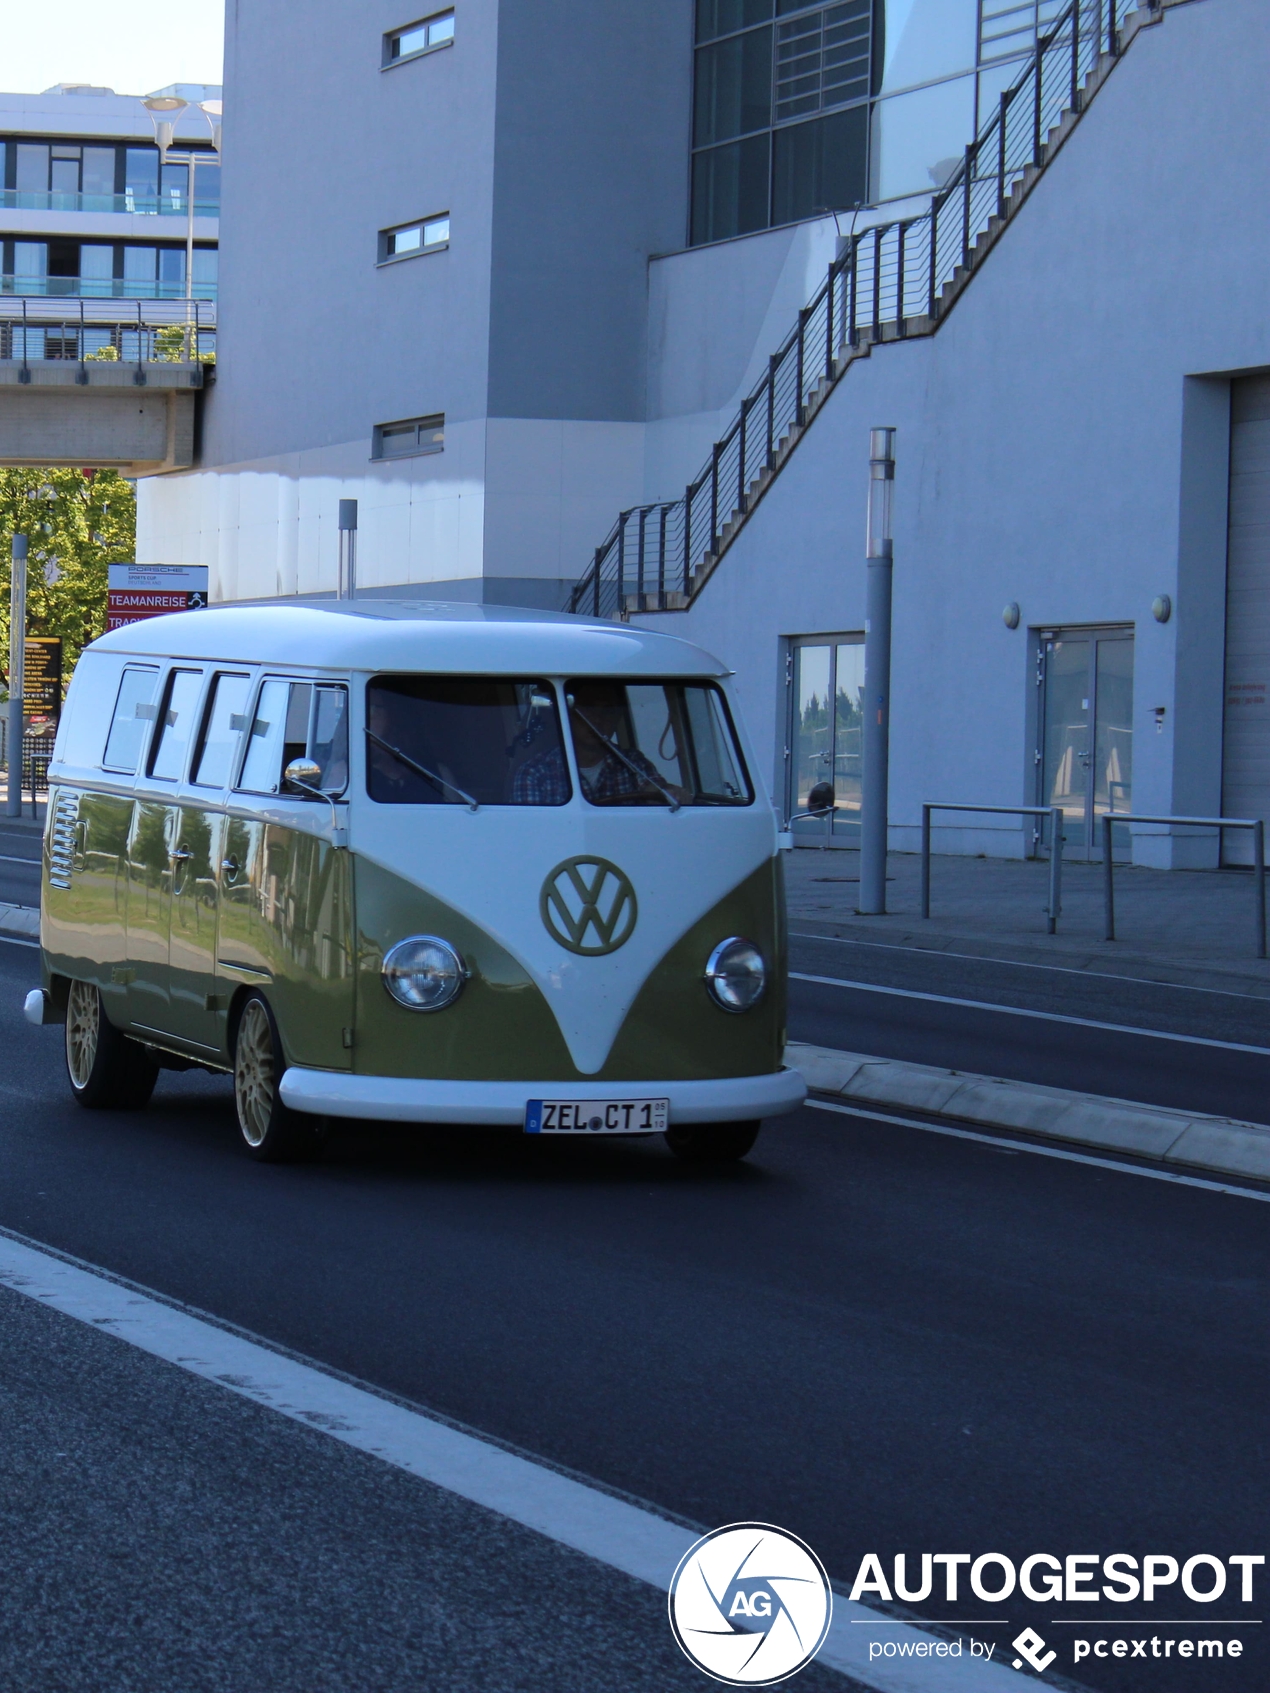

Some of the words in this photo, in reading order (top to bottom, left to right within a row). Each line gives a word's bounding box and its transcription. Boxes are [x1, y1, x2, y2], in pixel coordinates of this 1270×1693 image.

[109, 595, 186, 608] TEAMANREISE
[655, 1102, 666, 1111] 05
[542, 1105, 587, 1130] ZEL
[605, 1104, 635, 1129] CT
[640, 1104, 652, 1129] 1
